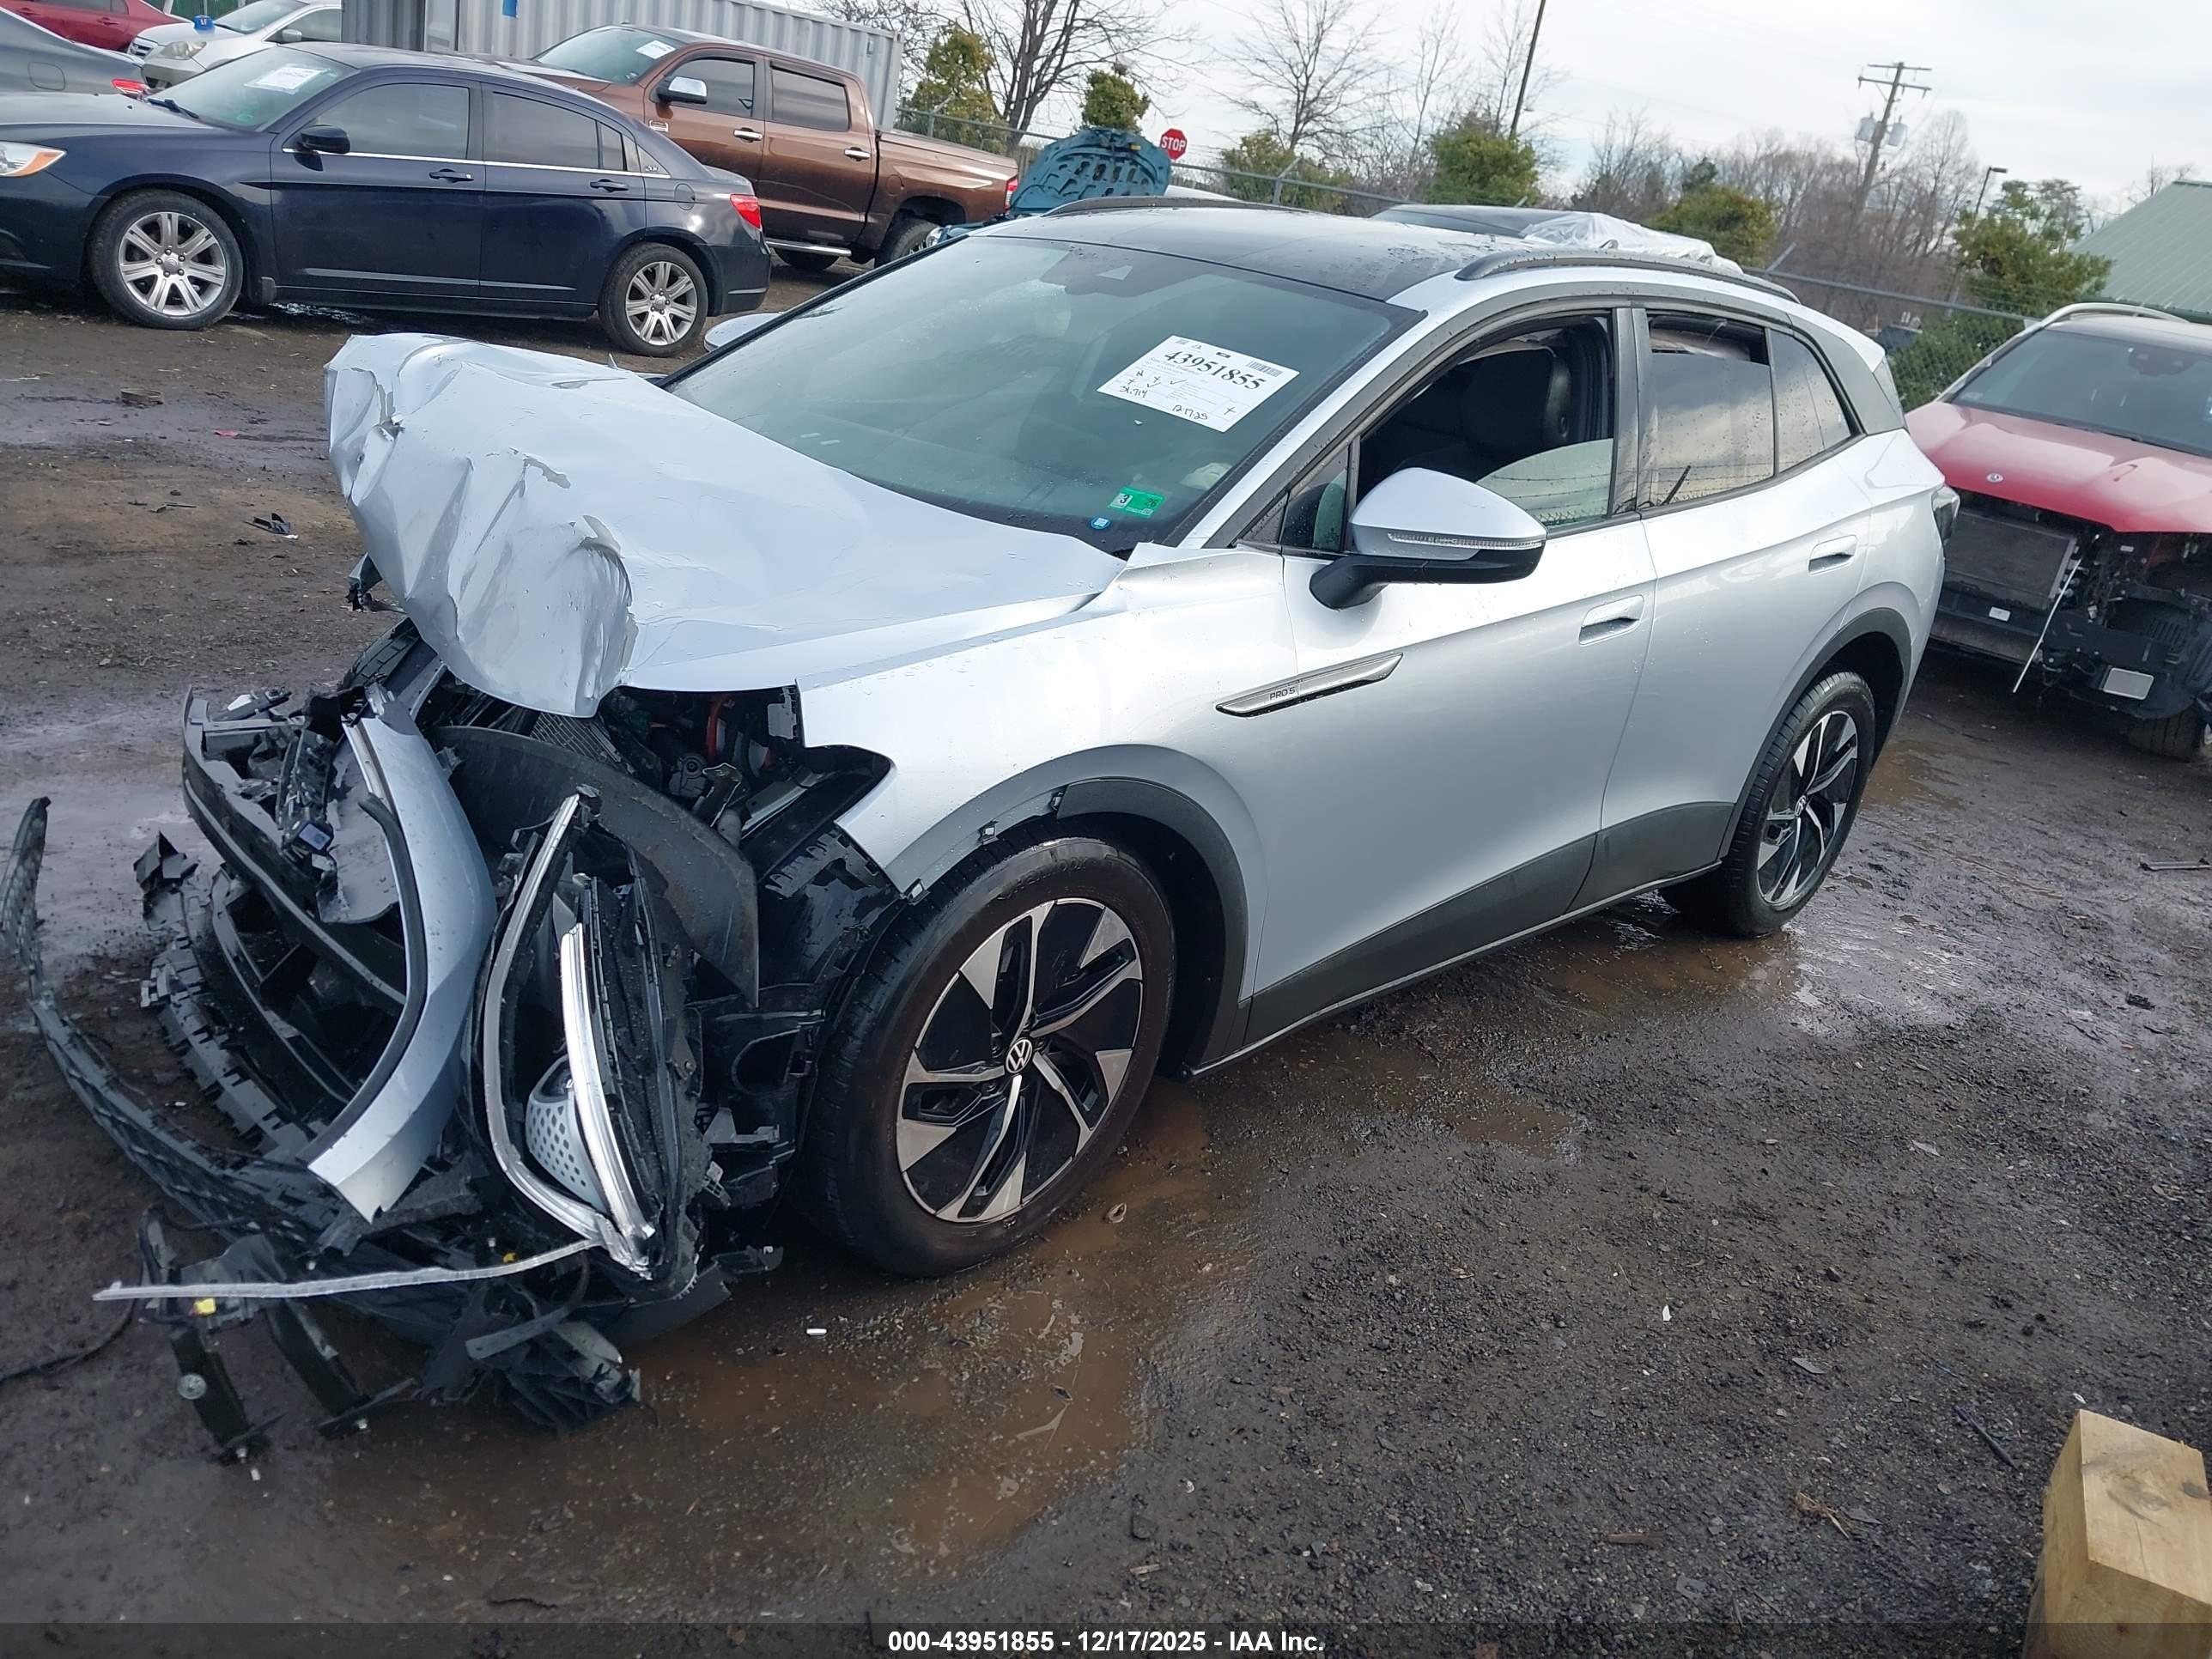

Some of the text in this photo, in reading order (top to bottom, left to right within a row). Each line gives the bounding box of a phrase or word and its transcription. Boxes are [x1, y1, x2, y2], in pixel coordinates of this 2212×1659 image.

[1161, 136, 1185, 152] STOP
[1164, 351, 1267, 390] 43951855
[1120, 495, 1159, 507] 3 26
[1270, 690, 1288, 700] PRO
